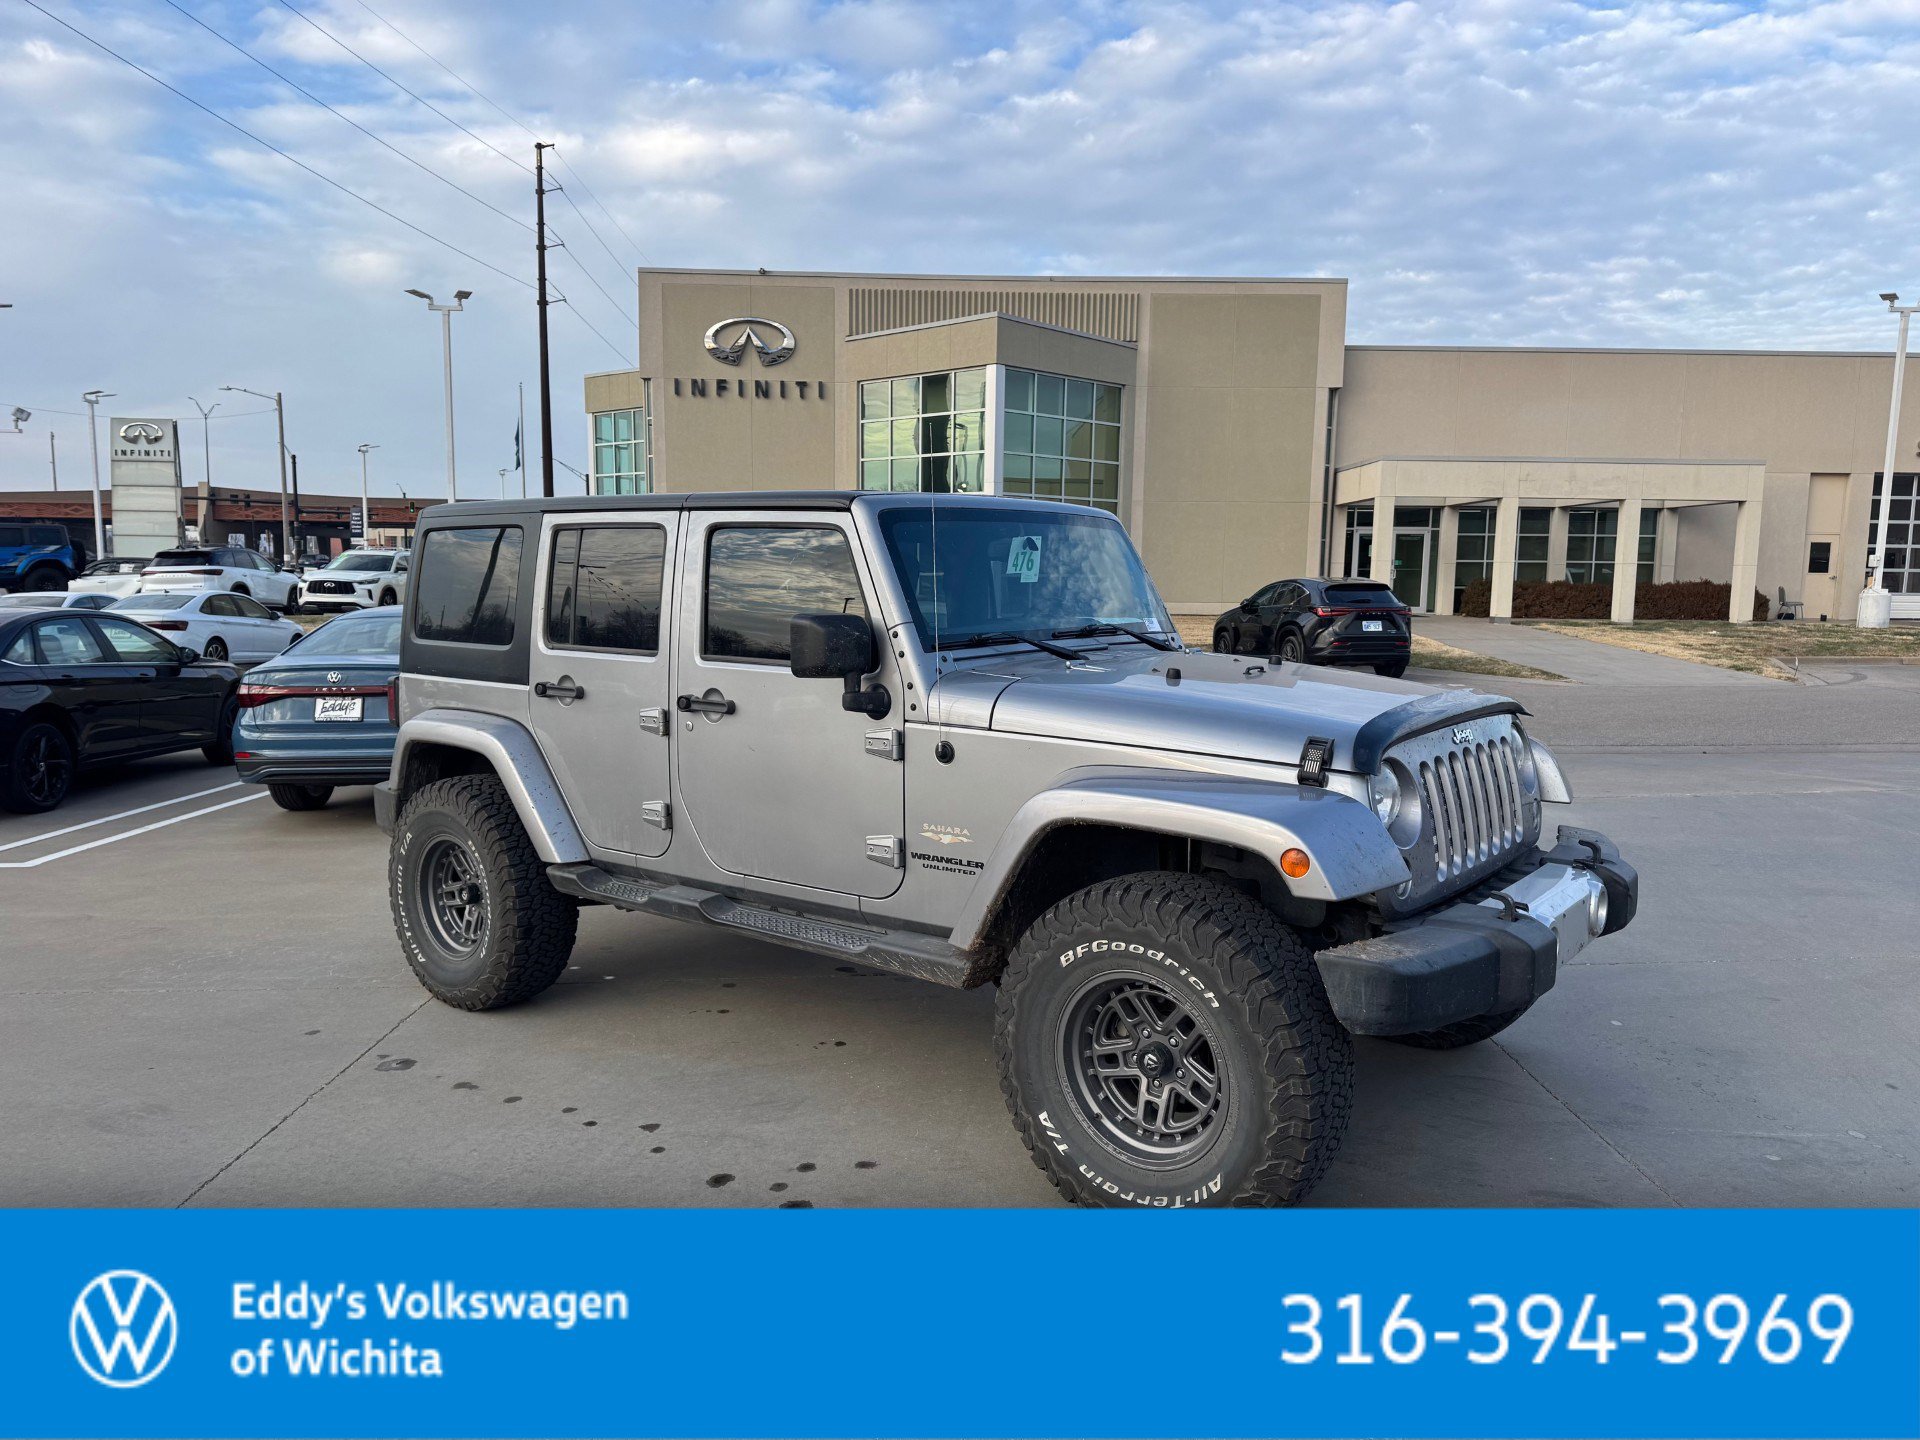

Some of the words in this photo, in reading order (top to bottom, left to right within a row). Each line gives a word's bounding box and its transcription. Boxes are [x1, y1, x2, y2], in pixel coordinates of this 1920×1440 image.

[674, 377, 825, 400] INFINITI
[114, 449, 171, 457] INFINITI
[1012, 551, 1035, 572] 476
[1453, 728, 1473, 744] Jeep
[922, 823, 970, 835] SAHARA
[400, 831, 413, 856] T/A
[910, 852, 984, 870] WRANGLER
[922, 863, 976, 875] UNLIMITED
[1059, 939, 1220, 1008] BFGoodrich
[1038, 1110, 1069, 1156] T/A
[1078, 1164, 1221, 1209] All-Terrain
